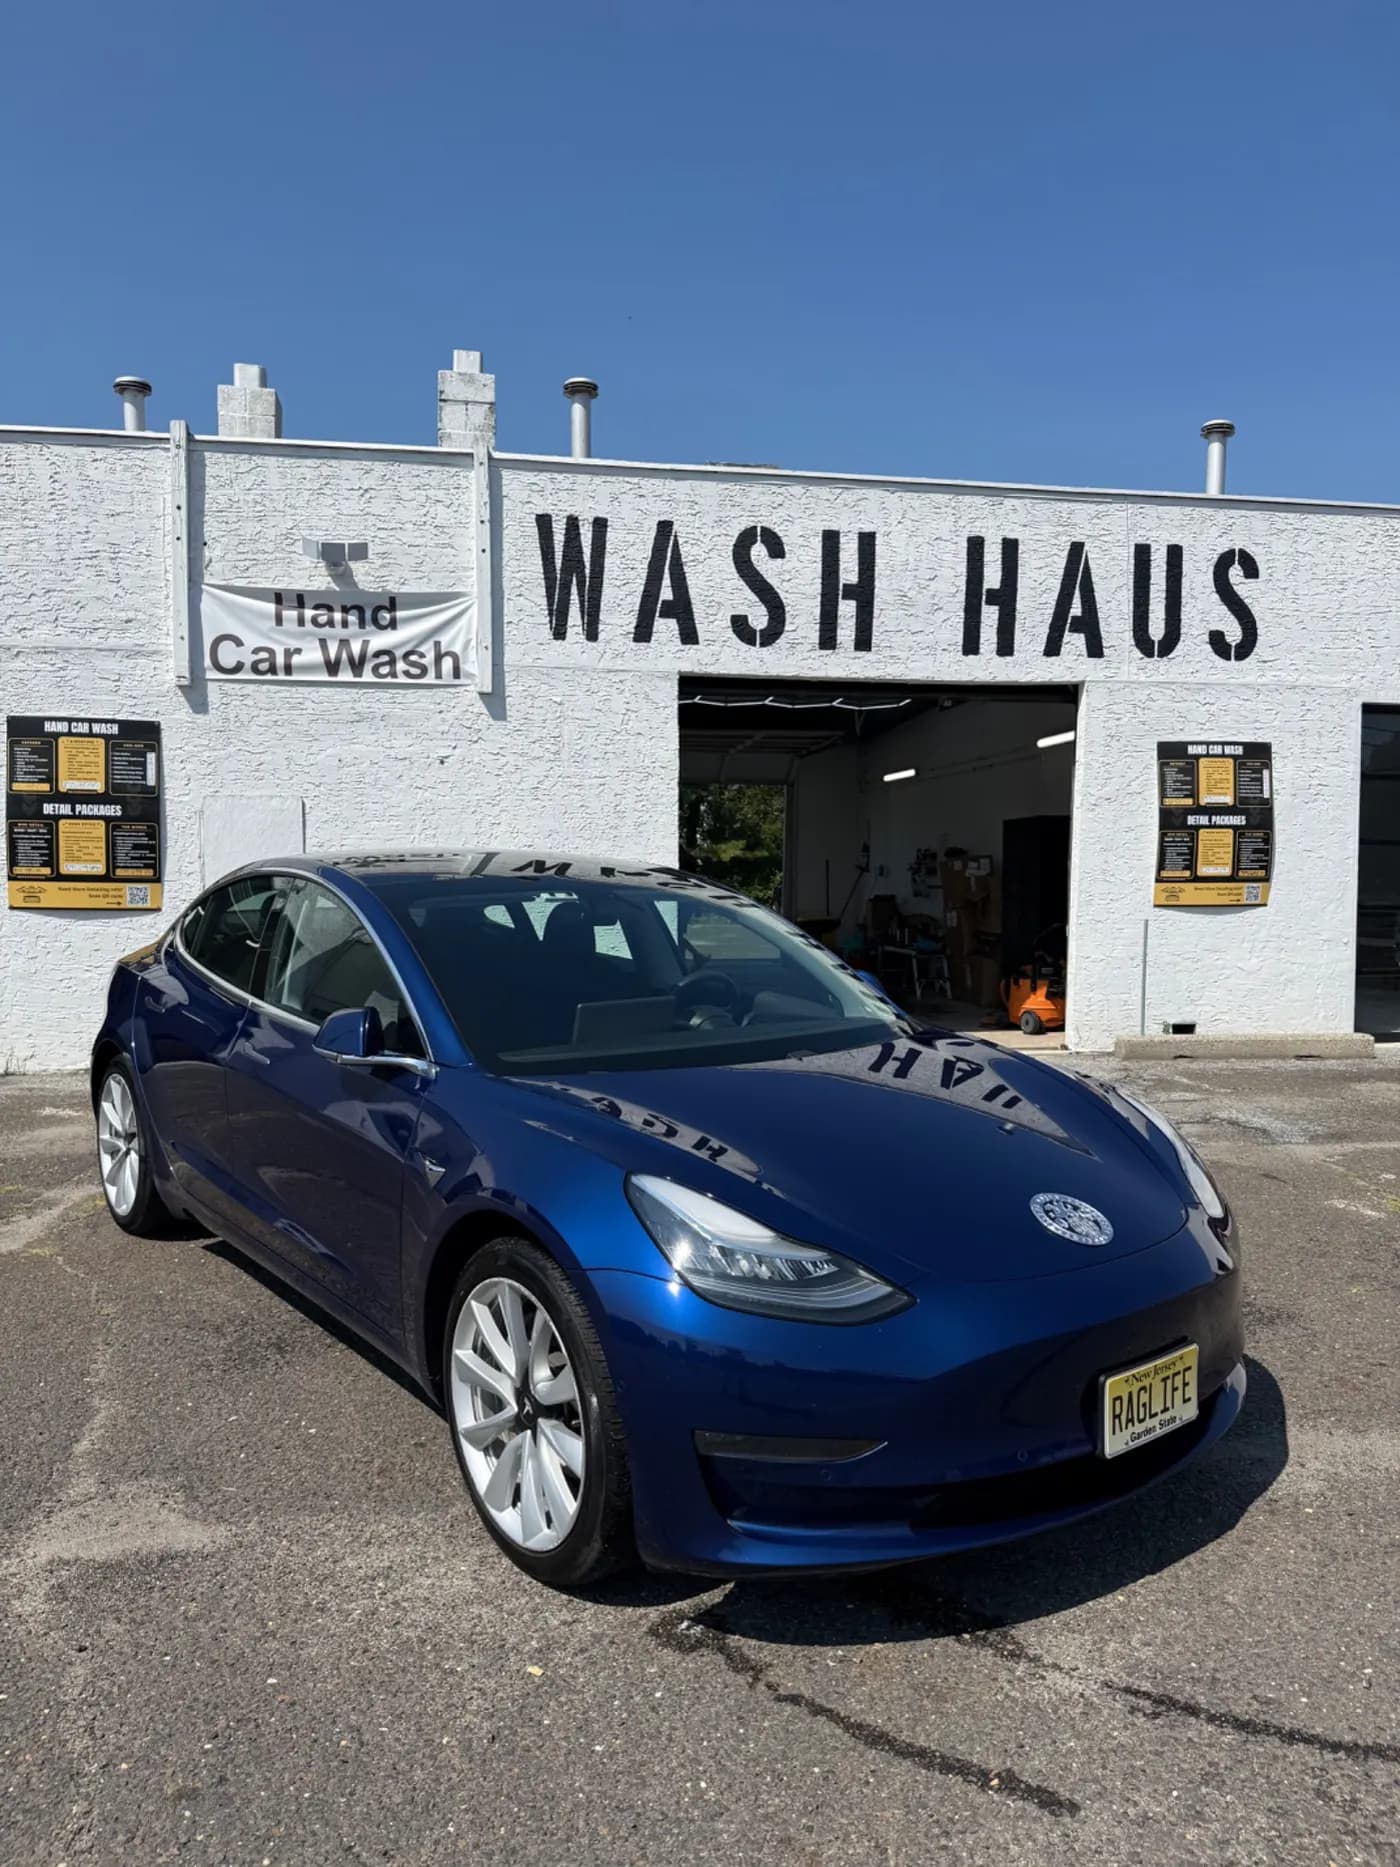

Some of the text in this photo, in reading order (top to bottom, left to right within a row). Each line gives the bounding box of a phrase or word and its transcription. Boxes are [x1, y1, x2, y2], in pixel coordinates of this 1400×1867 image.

[535, 513, 1260, 662] WASH HAUS
[273, 592, 398, 632] Hand
[208, 633, 462, 681] Car Wash
[44, 720, 119, 735] HAND CAR WASH
[1187, 744, 1244, 756] HAND CAR WASH
[43, 803, 123, 816] DETAIL PACKAGES
[1187, 815, 1247, 826] DETAIL PACKAGES
[1130, 1361, 1177, 1386] New Jersey
[1111, 1365, 1193, 1436] RAGLIFE
[1130, 1416, 1178, 1443] Garden State
